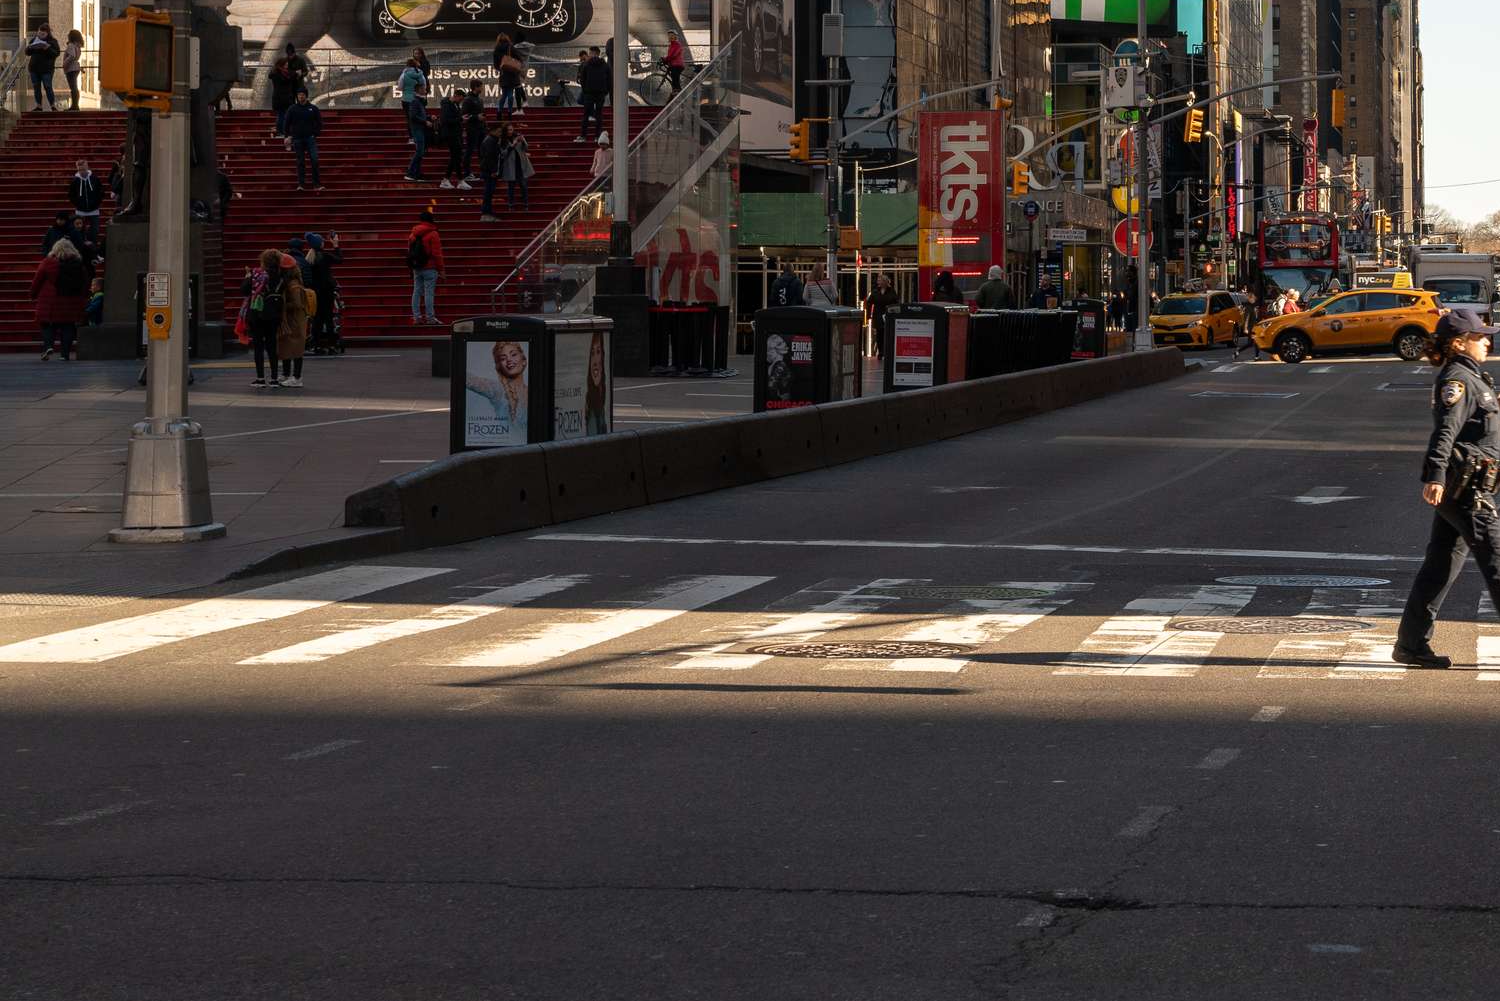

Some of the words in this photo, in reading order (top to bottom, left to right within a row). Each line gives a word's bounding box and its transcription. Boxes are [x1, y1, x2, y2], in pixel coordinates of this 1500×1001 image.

[939, 120, 989, 222] tkts
[1358, 275, 1375, 286] nyc
[791, 342, 813, 351] ERIKA
[791, 352, 813, 361] JAYNE
[467, 422, 510, 438] FROZEN
